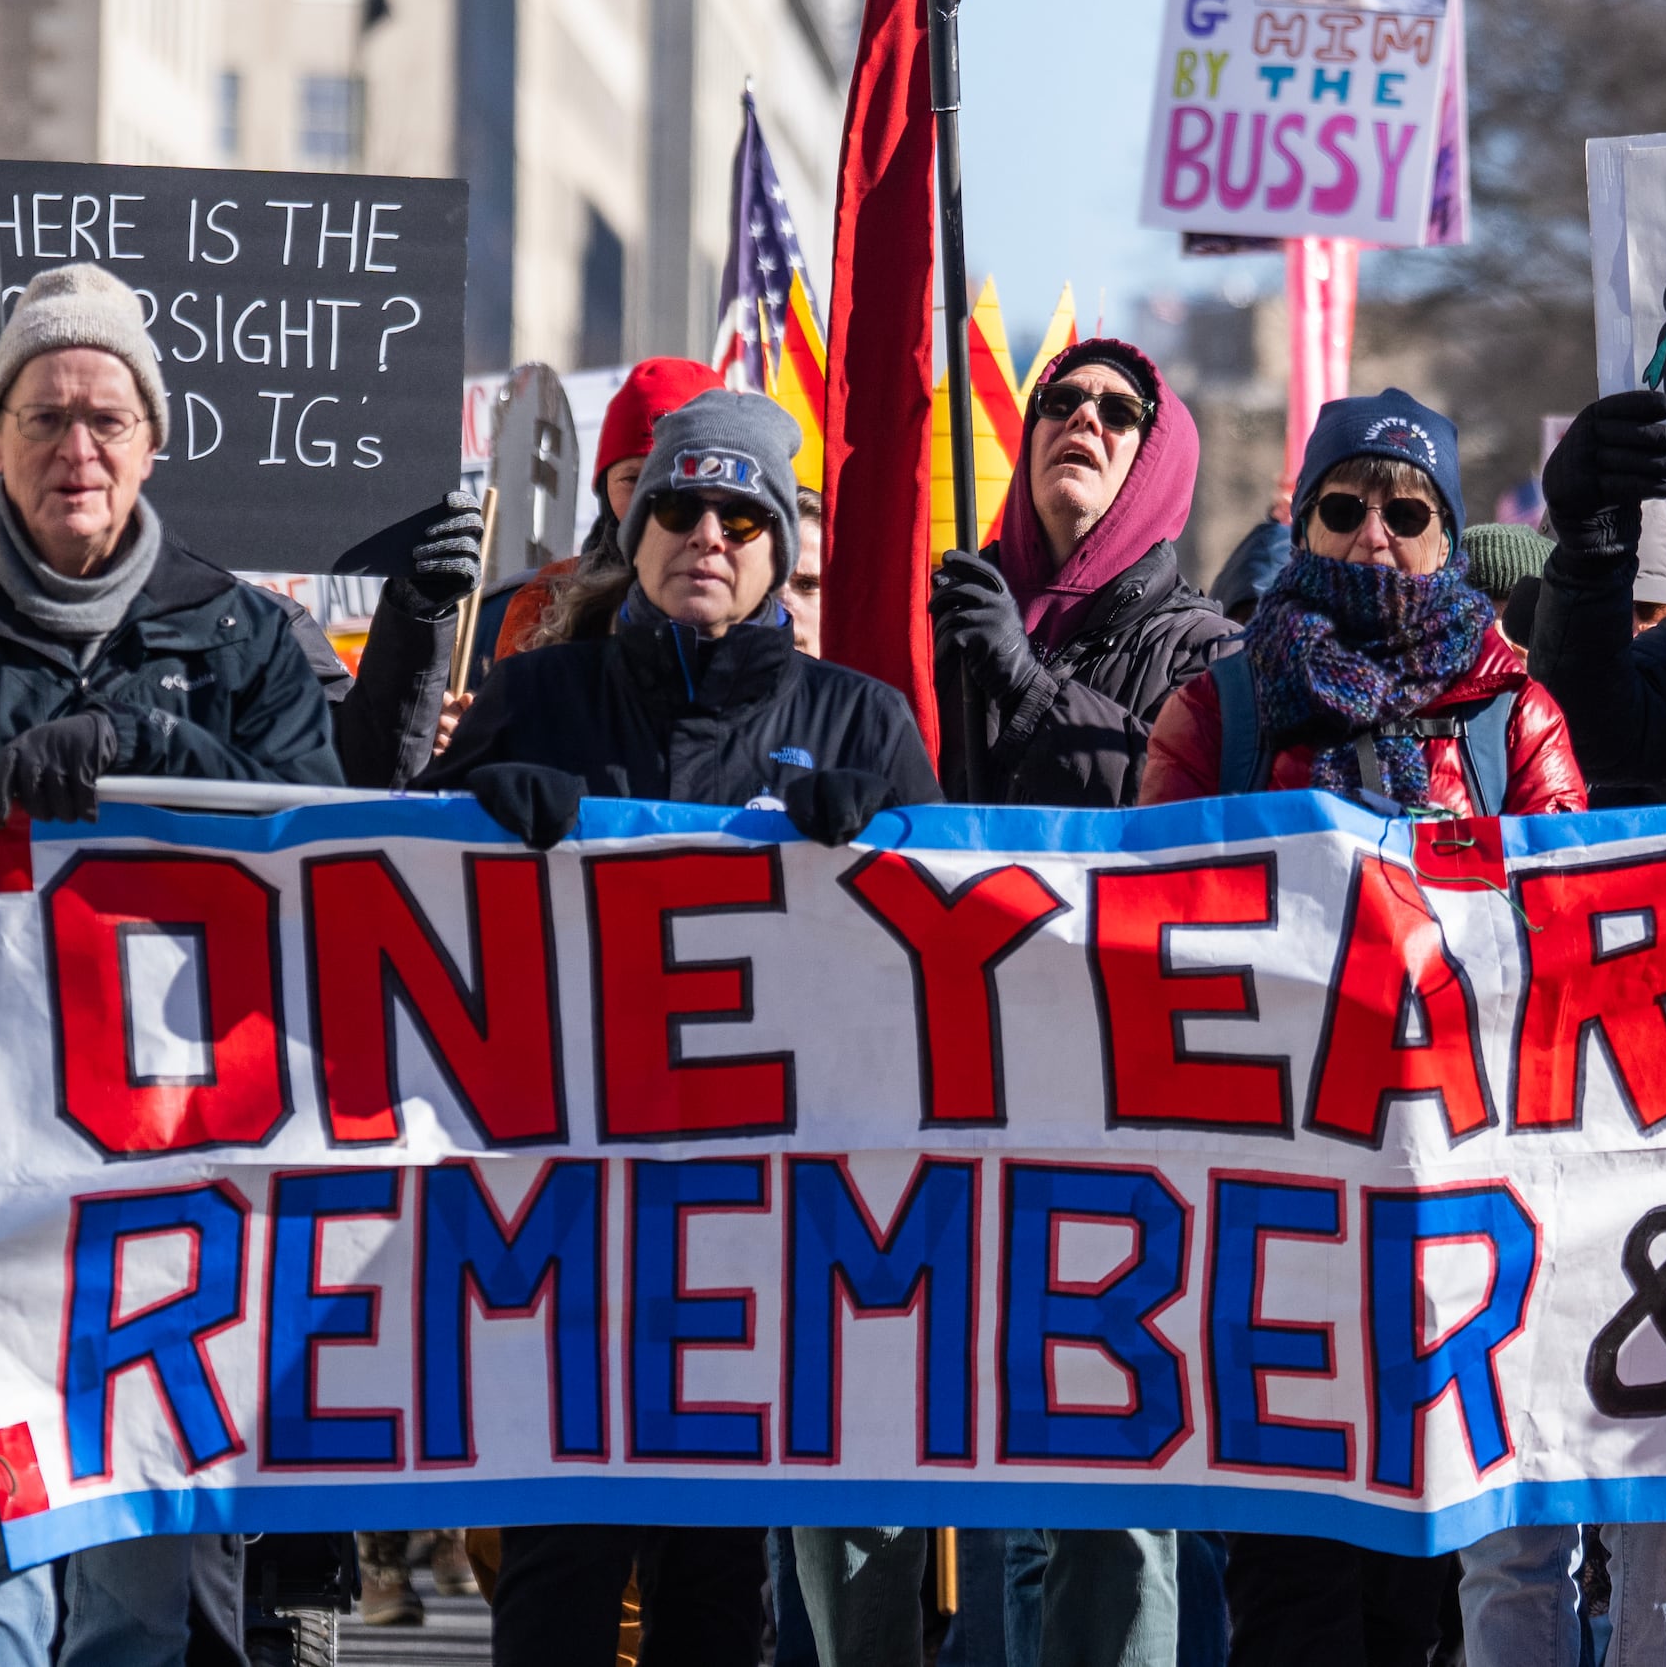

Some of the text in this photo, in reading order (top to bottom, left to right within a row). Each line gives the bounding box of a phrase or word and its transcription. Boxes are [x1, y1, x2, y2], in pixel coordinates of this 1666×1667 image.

[1251, 10, 1436, 66] HIM
[1172, 48, 1408, 107] BY THE
[1159, 105, 1420, 223] BUSSY
[187, 198, 241, 266] IS
[264, 200, 403, 274] THE
[1363, 416, 1408, 441] WHITE
[39, 845, 797, 1163] ONE
[63, 1153, 1543, 1499] REMEMBER
